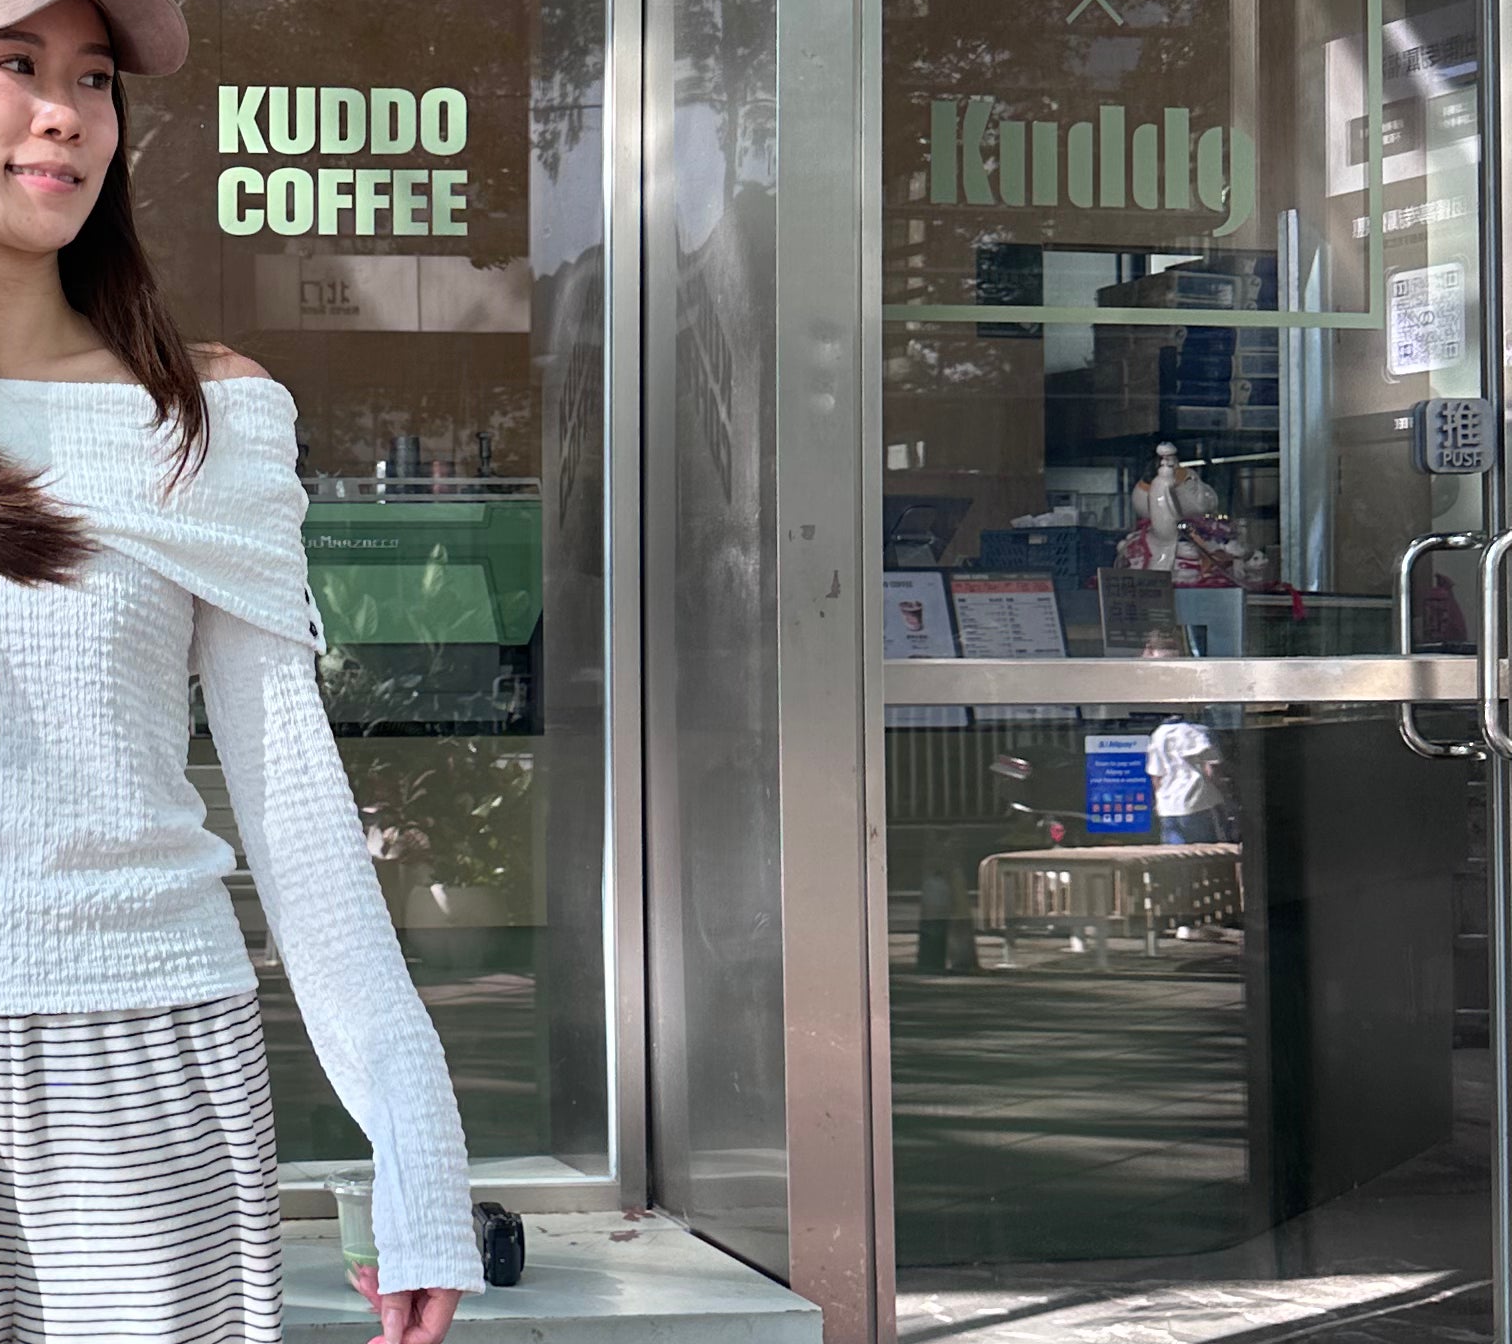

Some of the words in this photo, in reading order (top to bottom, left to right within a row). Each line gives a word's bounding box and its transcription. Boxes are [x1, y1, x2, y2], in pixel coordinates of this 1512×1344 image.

[219, 85, 468, 156] KUDDO
[218, 167, 468, 236] COFFEE
[1438, 402, 1482, 449] 推
